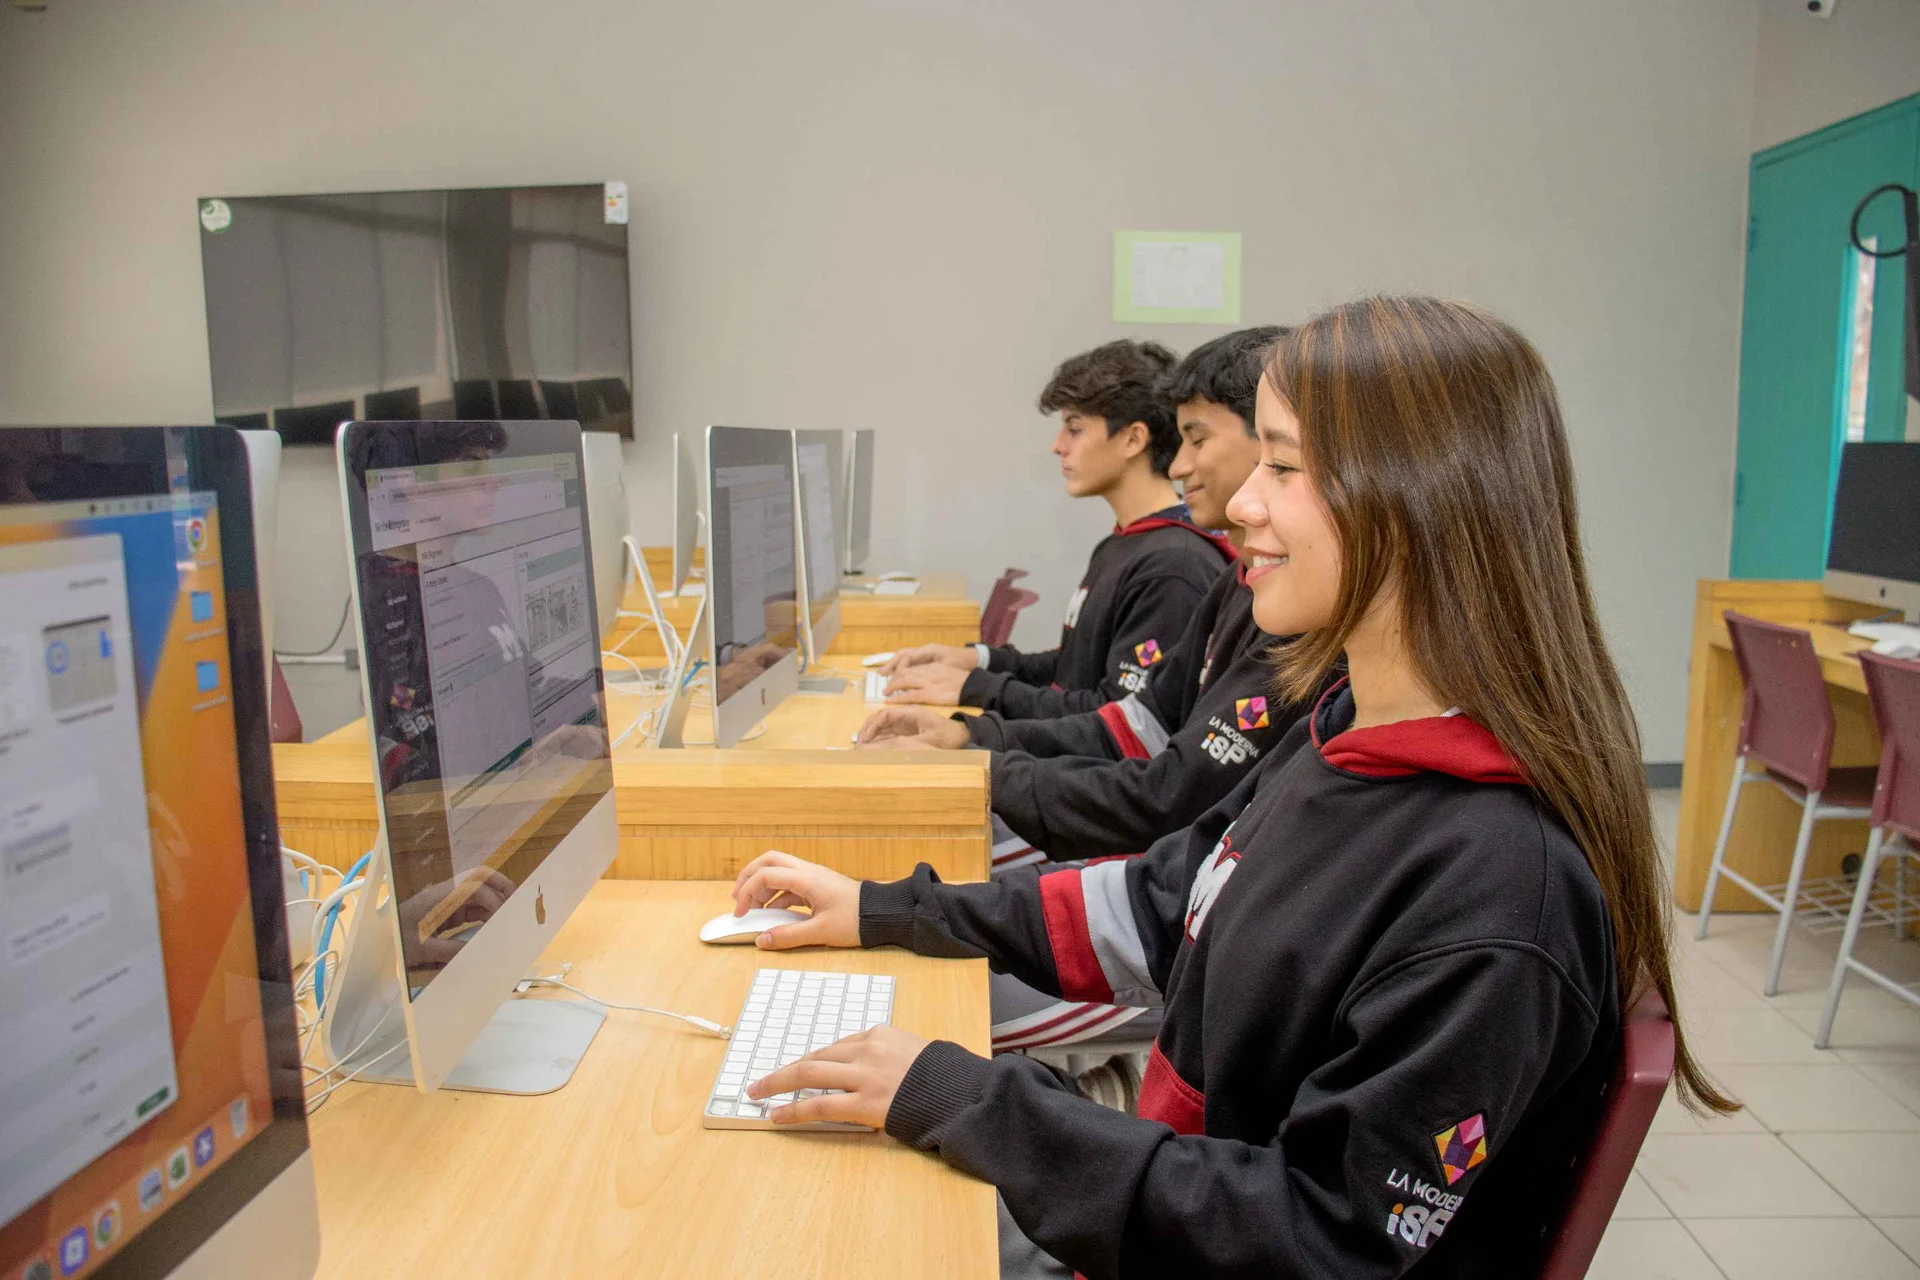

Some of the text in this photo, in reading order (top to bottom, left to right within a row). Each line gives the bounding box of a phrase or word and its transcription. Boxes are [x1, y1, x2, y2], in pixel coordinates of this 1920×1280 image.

[1208, 715, 1260, 758] LA MODERNA
[1386, 1168, 1409, 1192] LA
